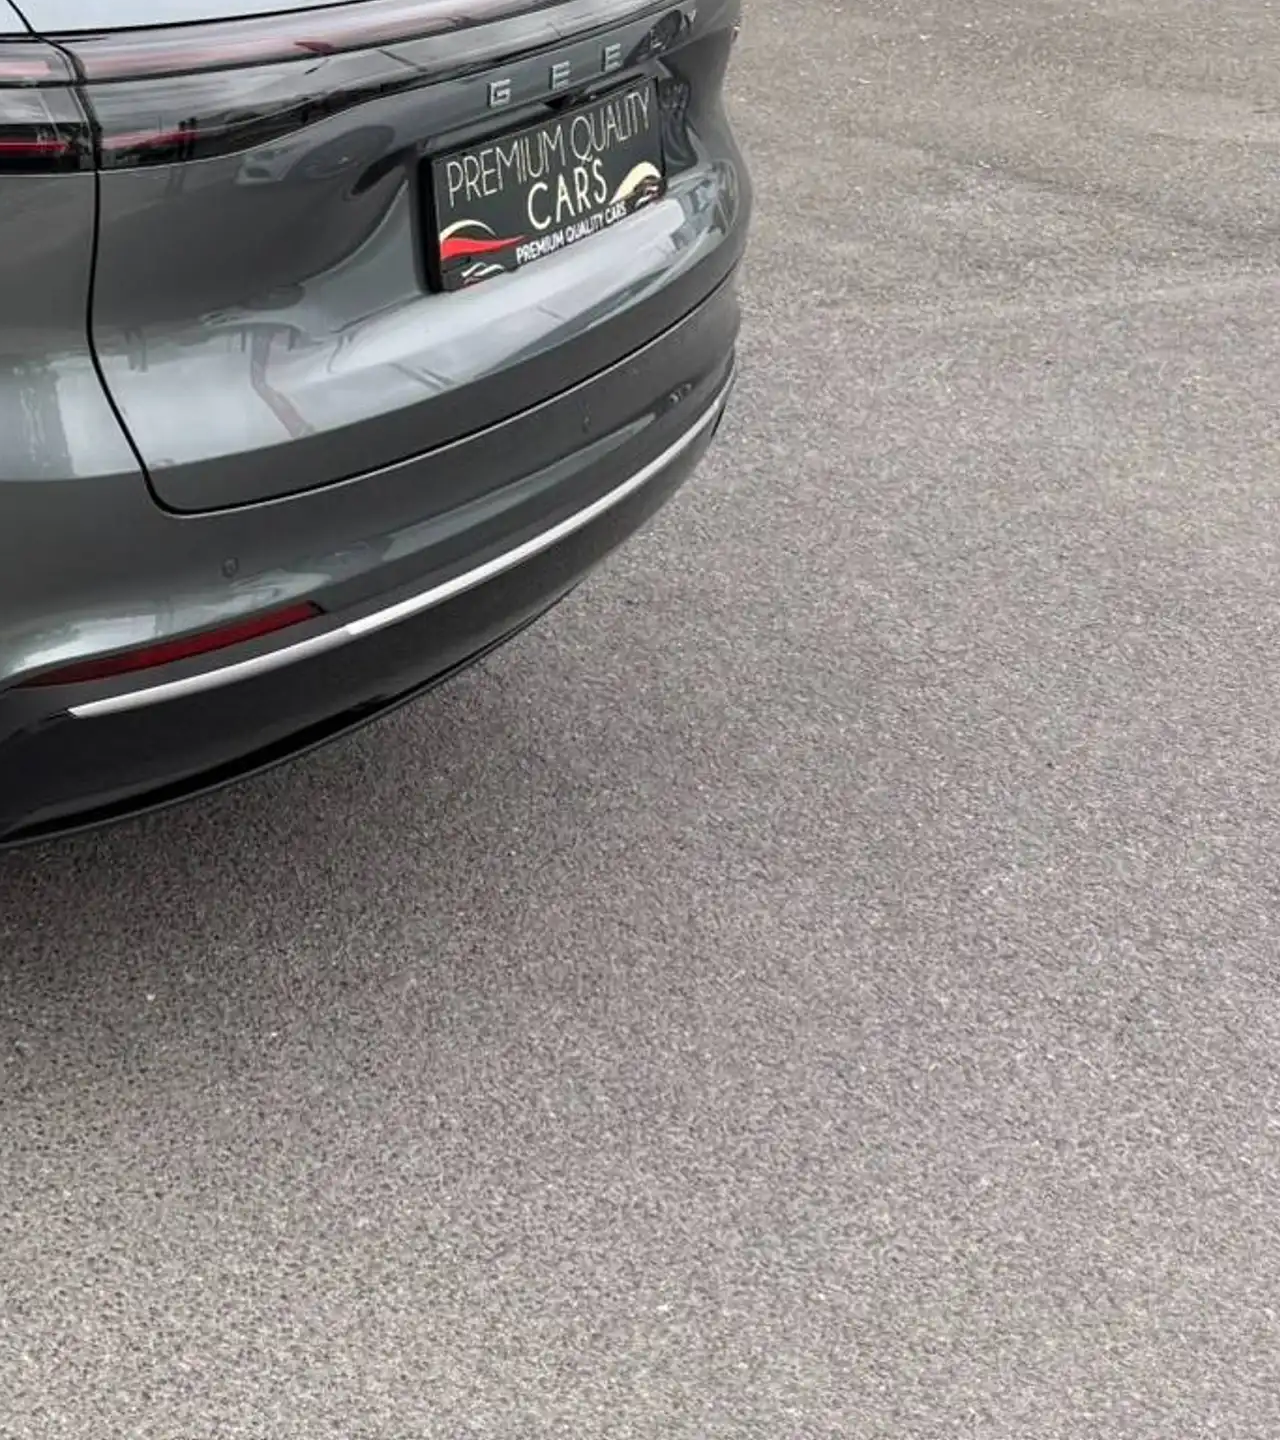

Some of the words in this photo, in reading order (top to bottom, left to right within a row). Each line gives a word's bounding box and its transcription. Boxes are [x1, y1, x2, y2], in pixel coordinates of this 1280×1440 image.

[446, 124, 566, 208] PREMIUM
[570, 87, 649, 166] QUALITY
[527, 157, 608, 230] CARS
[516, 229, 565, 264] PREMIUM
[565, 210, 604, 243] QUALITY
[604, 201, 627, 224] CARS
